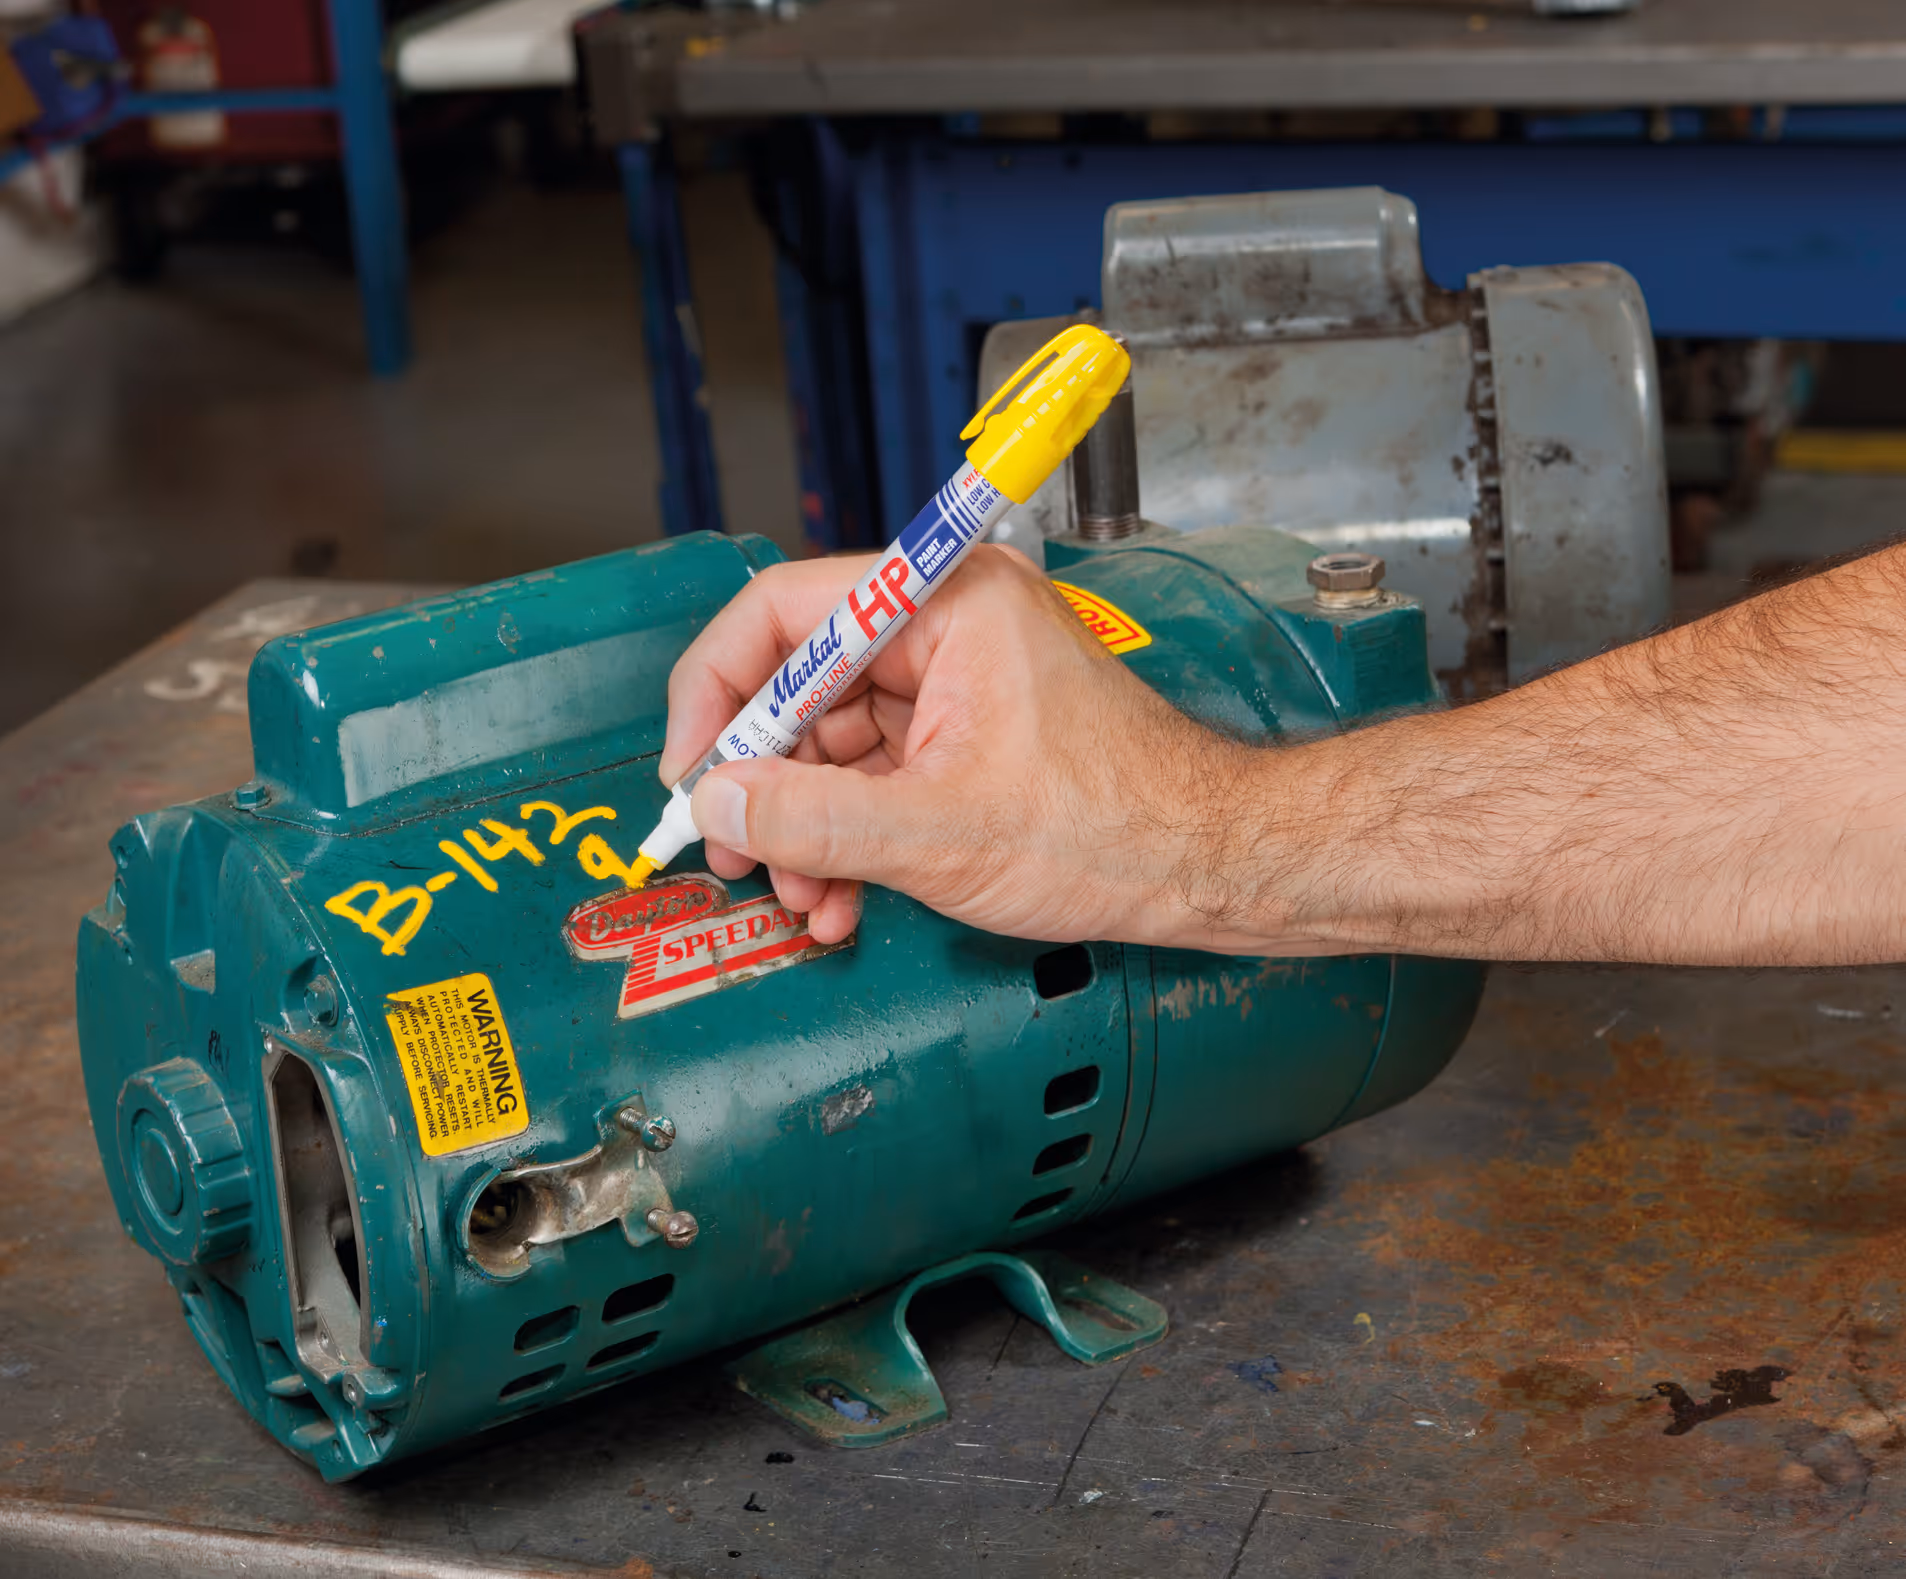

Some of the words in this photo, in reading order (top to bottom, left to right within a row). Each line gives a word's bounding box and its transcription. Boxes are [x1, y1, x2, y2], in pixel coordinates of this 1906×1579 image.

[966, 484, 984, 505] LOW
[976, 493, 994, 515] LOW
[916, 538, 941, 568] PAINT
[922, 538, 958, 577] MARKER
[848, 557, 918, 641] HP
[1070, 601, 1118, 635] RO
[768, 613, 842, 719] Markal
[797, 712, 817, 737] HIGH
[818, 650, 874, 713] PERFORMANCE
[450, 988, 464, 1010] THIS
[460, 1014, 477, 1049] MOTOR
[405, 1001, 422, 1035] ALWAYS
[417, 1038, 440, 1100] DISCONNECT
[435, 1102, 449, 1138] POWER
[416, 996, 431, 1025] WHEN
[427, 1030, 450, 1088] PROTECTOR
[445, 1094, 460, 1135] RESETS.
[427, 994, 459, 1075] AUTOMATICALLY
[455, 1084, 472, 1130] RESTART
[440, 991, 468, 1060] PROTECTED
[464, 1068, 476, 1093] AND
[472, 1099, 484, 1128] WILL
[467, 988, 518, 1116] WARNING
[472, 1054, 481, 1064] IS
[406, 1041, 423, 1080] BEFORE
[418, 1085, 437, 1140] SERVICING.
[476, 1068, 496, 1124] THERMALLY
